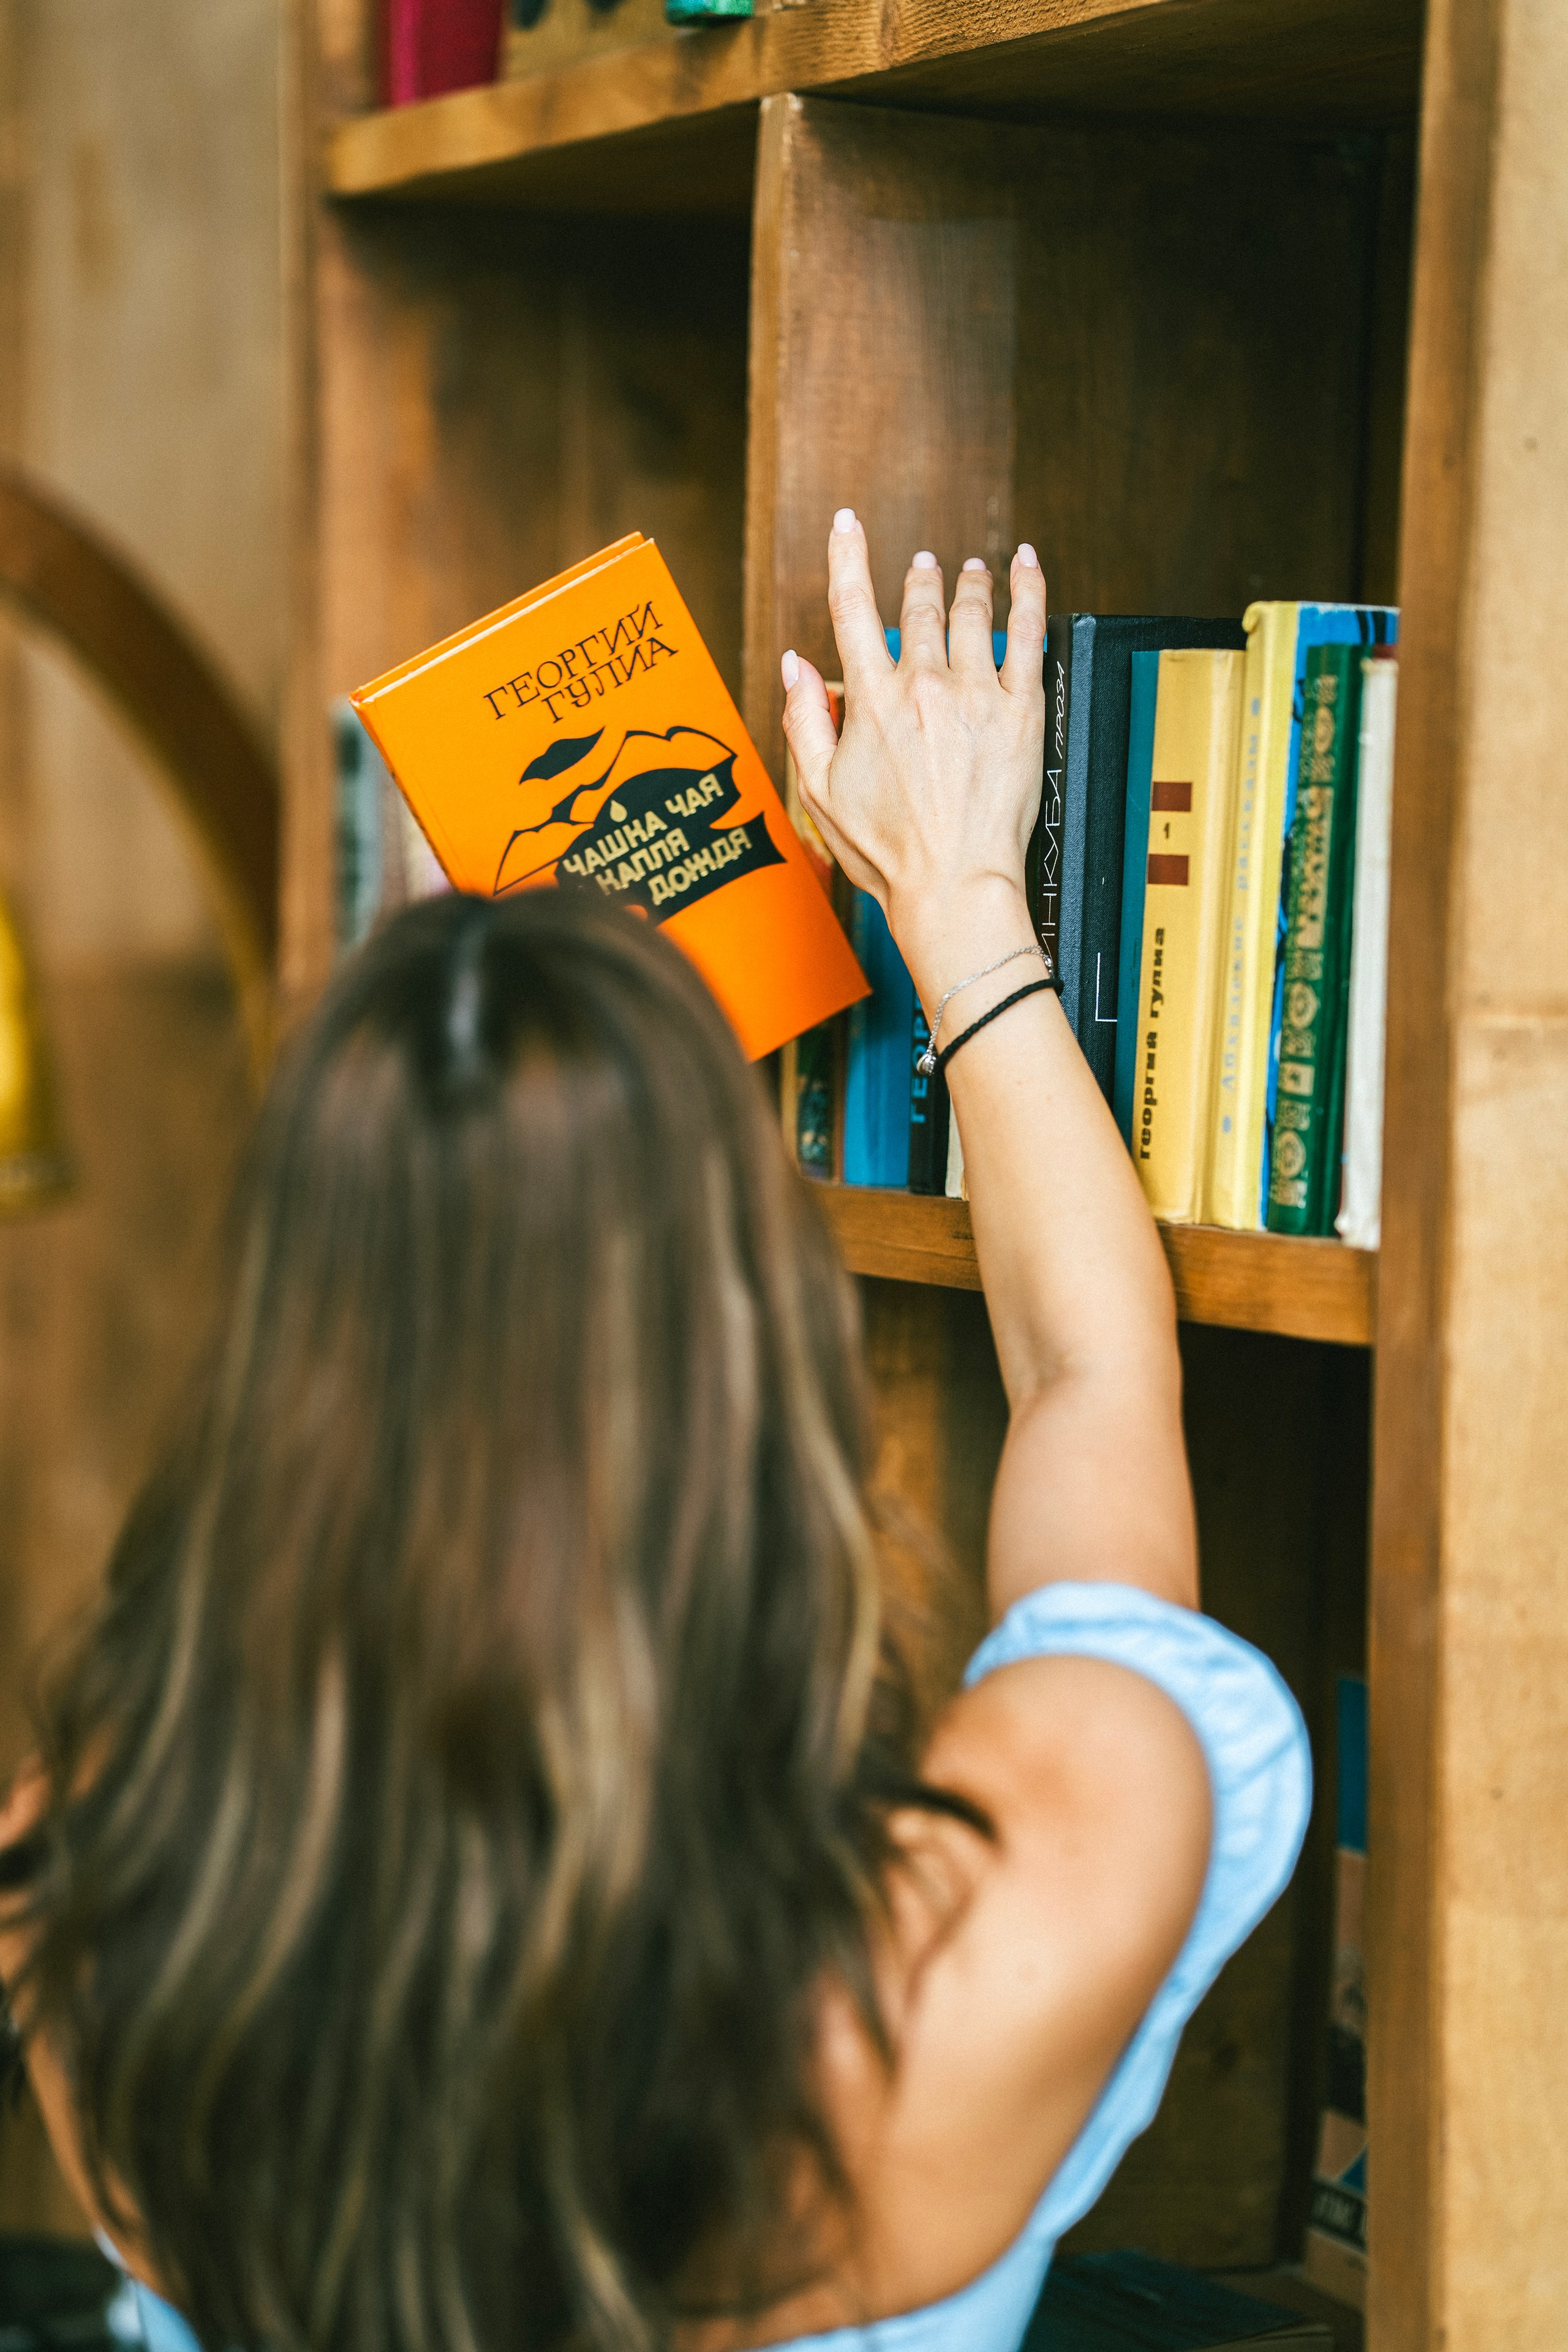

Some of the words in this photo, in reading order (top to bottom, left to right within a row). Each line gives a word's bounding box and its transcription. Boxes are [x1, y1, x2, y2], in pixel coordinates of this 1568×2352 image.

[483, 600, 663, 720] ГЕОРГИЙ
[541, 636, 679, 723] ГУЛИА
[562, 810, 668, 876] ЧАШКА
[664, 772, 725, 818] ЧАЯ
[595, 827, 690, 896] КАПЛЯ
[1041, 769, 1063, 968] ИНКУБА
[1055, 660, 1065, 760] ПРОЗА
[647, 827, 753, 907] ДОЖДЯ
[1148, 927, 1166, 1020] гулиа
[1139, 1030, 1158, 1161] георгий
